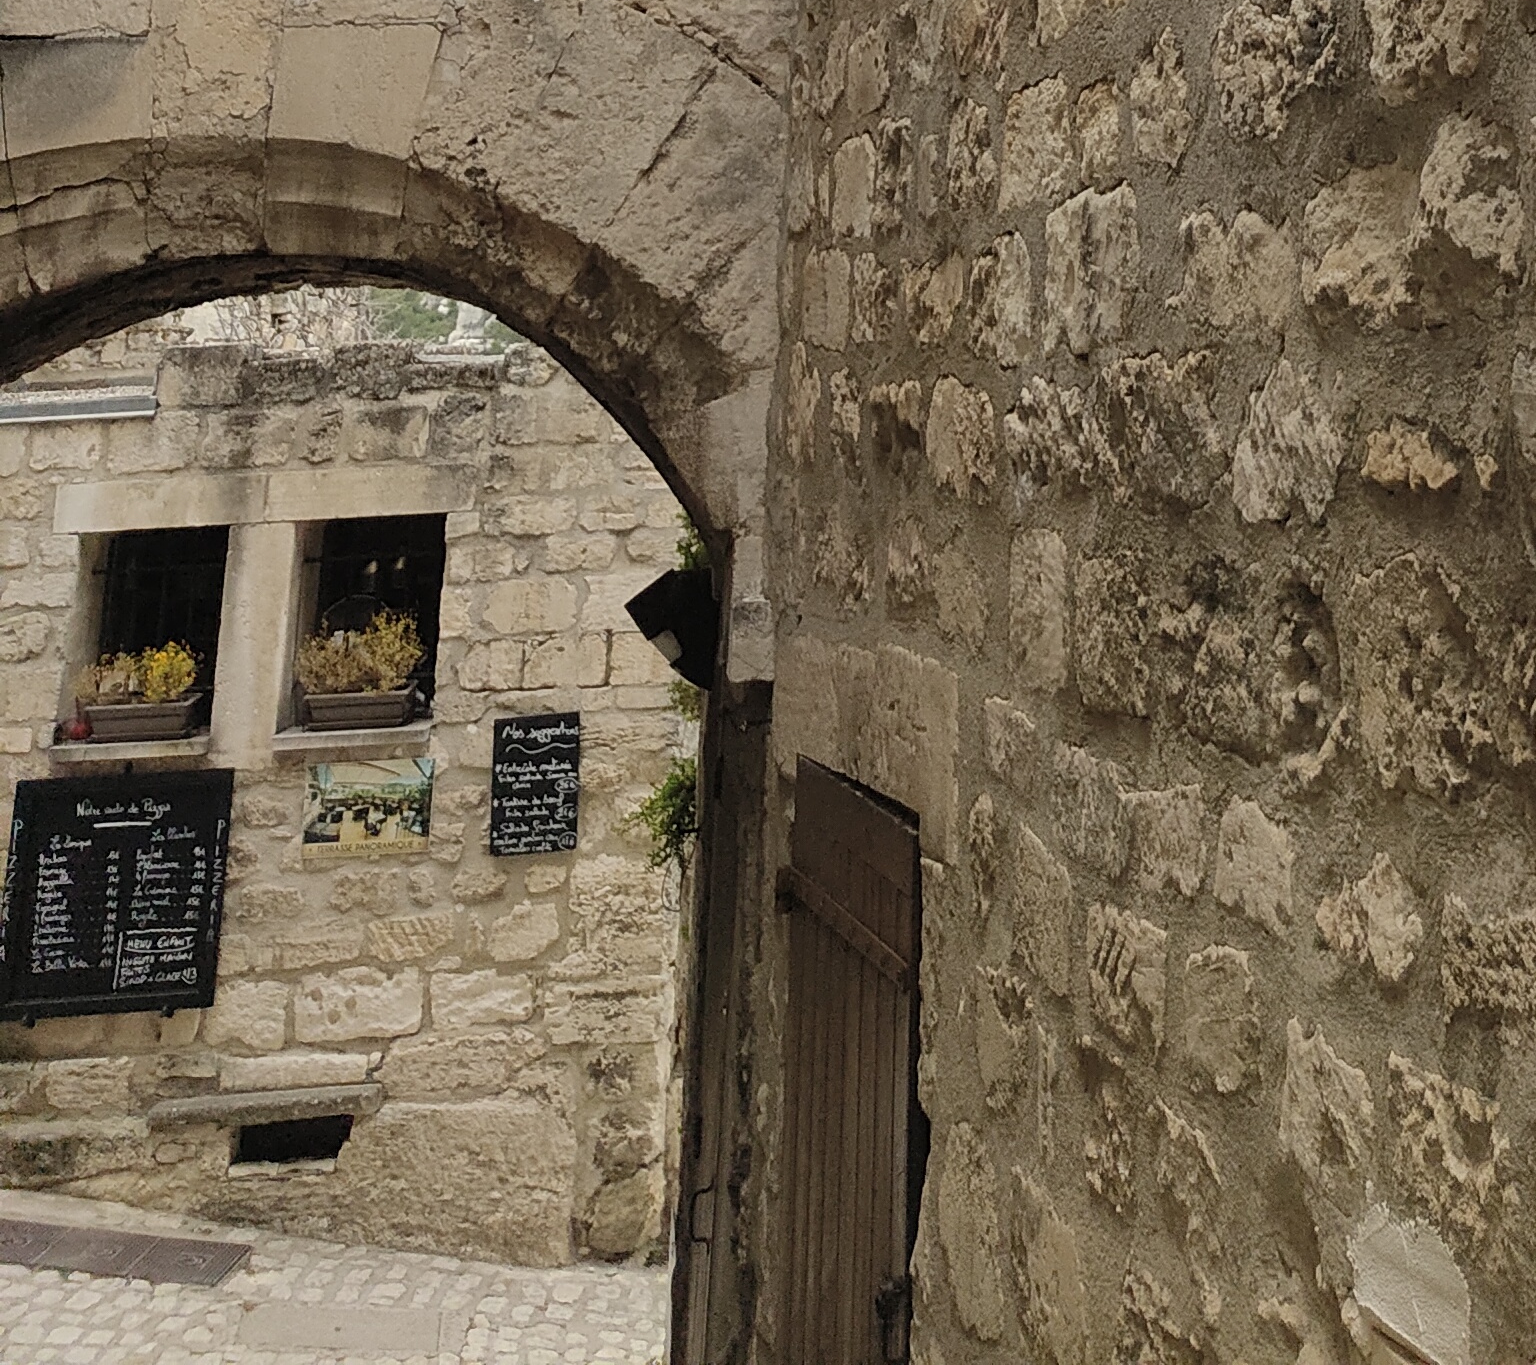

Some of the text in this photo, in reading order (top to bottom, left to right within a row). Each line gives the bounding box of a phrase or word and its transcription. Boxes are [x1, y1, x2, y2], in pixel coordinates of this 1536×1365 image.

[501, 722, 525, 740] Nos
[317, 839, 414, 853] TERRASSE PANORAMIQUE
[127, 938, 153, 950] MENU
